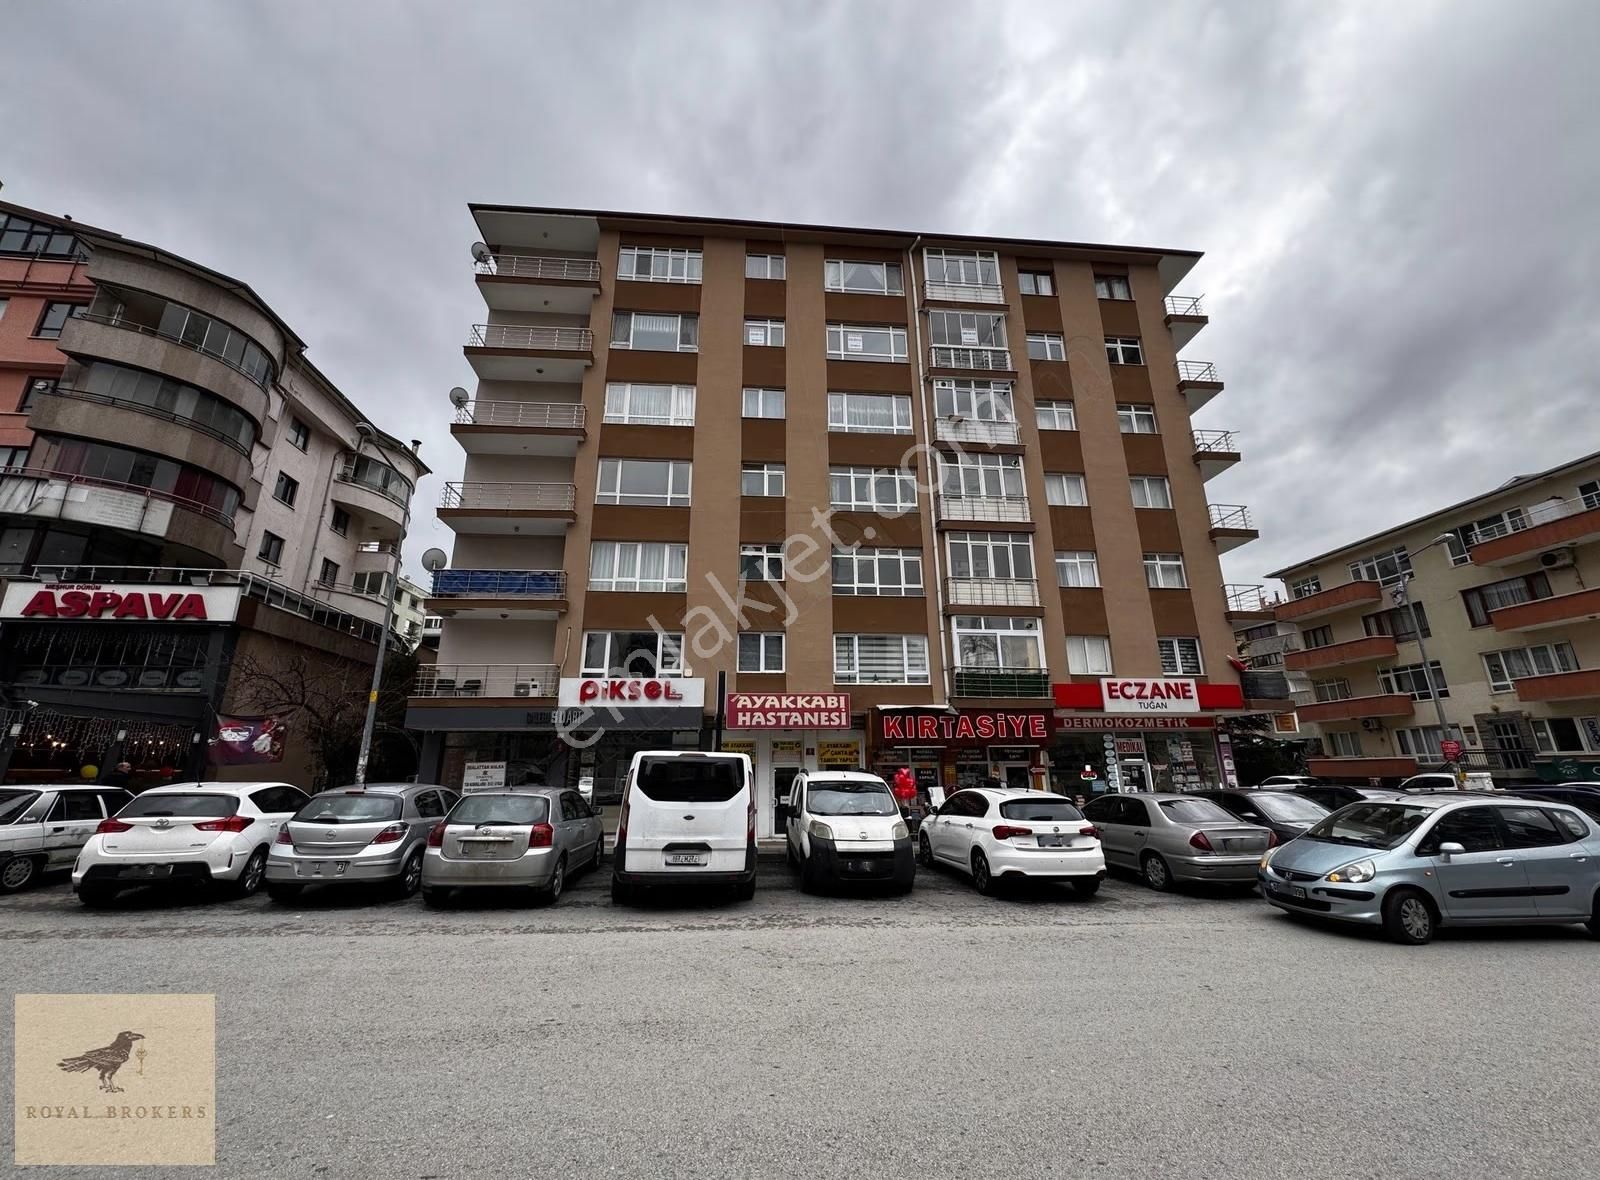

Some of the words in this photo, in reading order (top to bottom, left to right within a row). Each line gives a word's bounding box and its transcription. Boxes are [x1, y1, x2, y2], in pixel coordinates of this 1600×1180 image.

[20, 590, 208, 619] ASPAVA
[1106, 681, 1194, 700] ECZANE
[736, 695, 846, 709] AYAKKABI
[1138, 700, 1168, 710] TUĞAN
[737, 708, 847, 726] HASTANESİ
